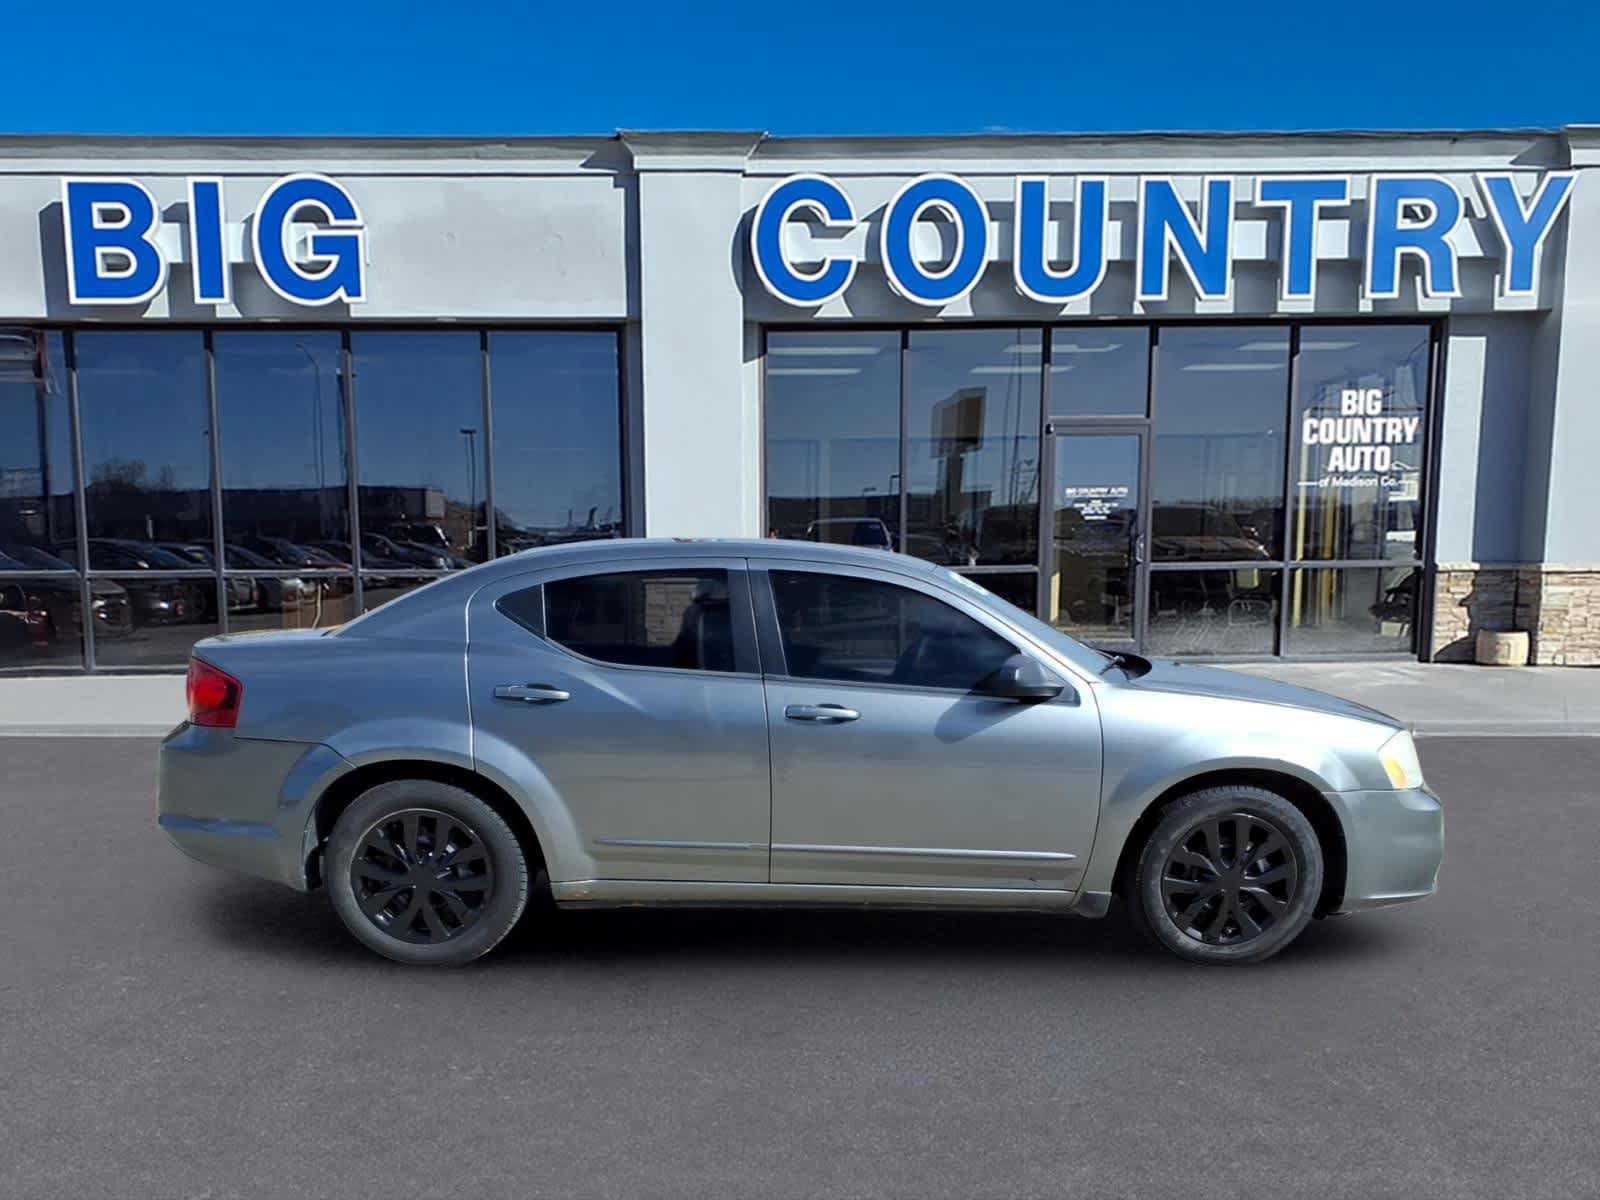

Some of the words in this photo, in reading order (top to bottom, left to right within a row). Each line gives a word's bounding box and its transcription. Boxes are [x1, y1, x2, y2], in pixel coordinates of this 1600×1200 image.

[62, 173, 367, 306] BIG
[751, 172, 1577, 307] COUNTRY
[1341, 389, 1382, 416] BIG
[1302, 417, 1419, 444] COUNTRY
[1327, 446, 1391, 472] AUTO
